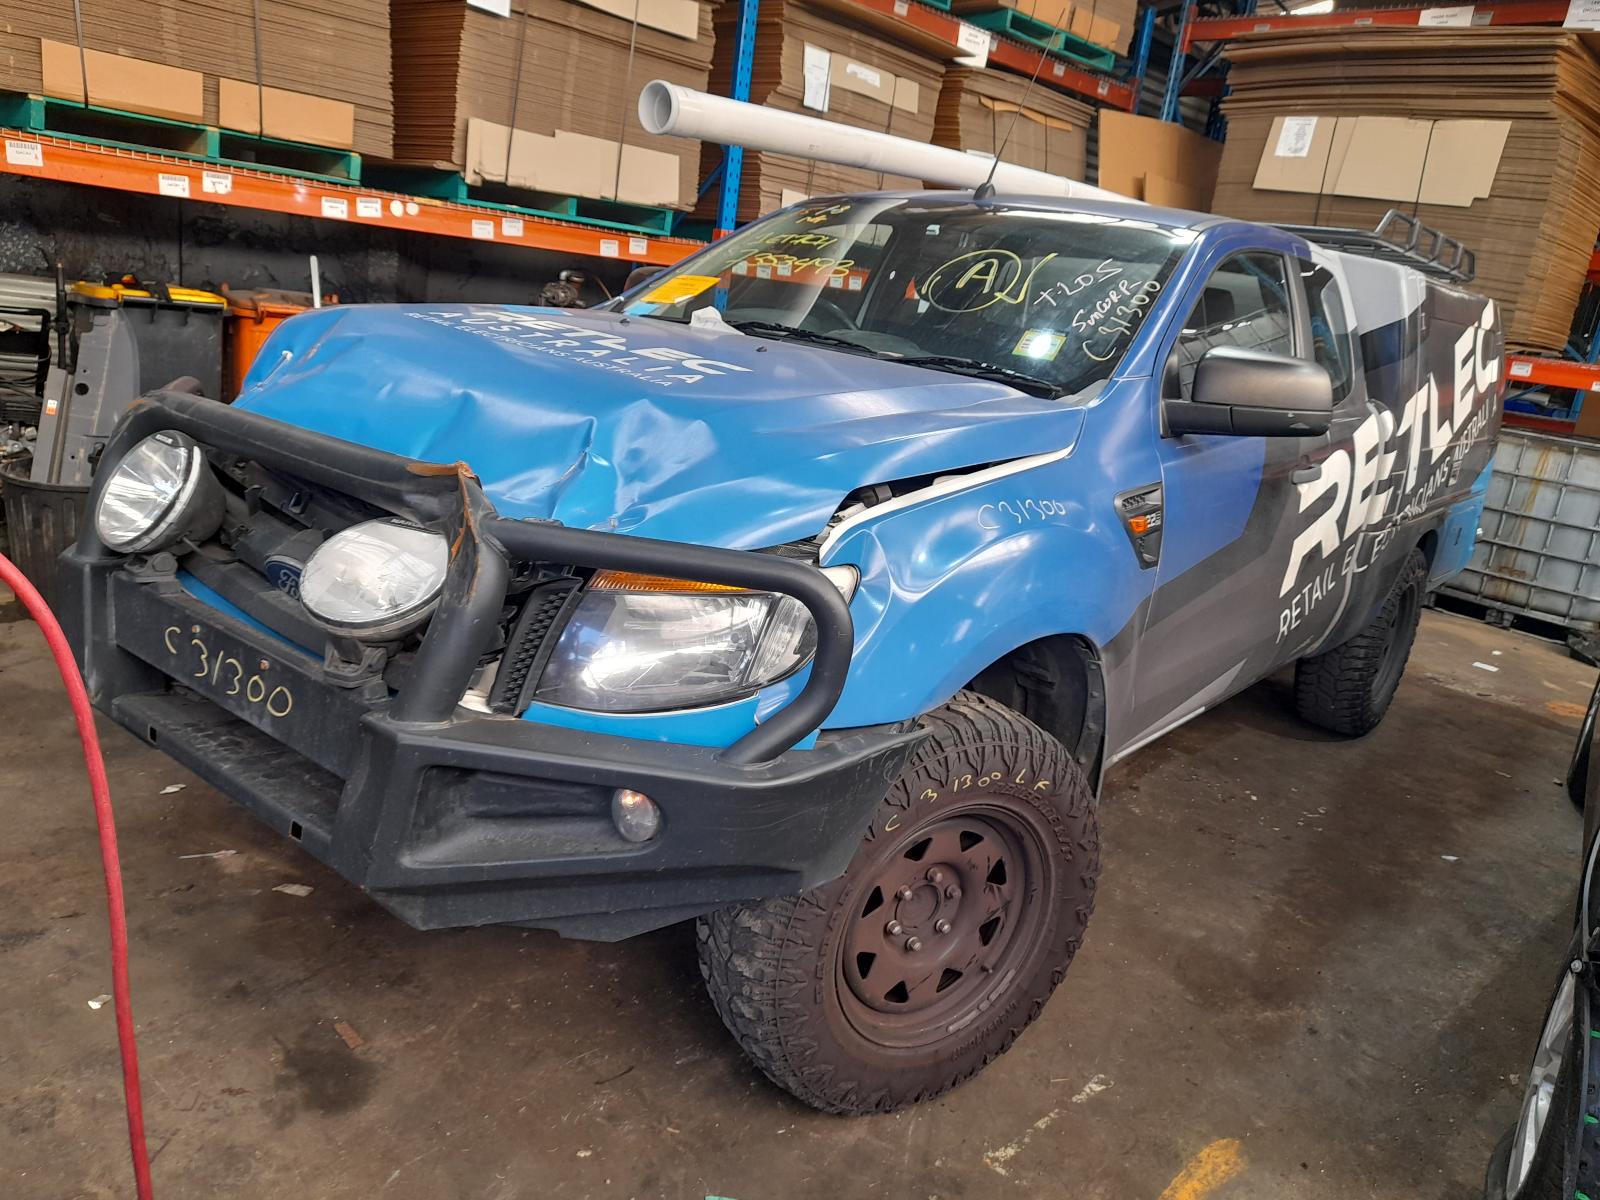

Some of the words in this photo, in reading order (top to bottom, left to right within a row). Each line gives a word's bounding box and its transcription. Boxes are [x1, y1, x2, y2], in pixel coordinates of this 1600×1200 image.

[955, 258, 999, 294] A
[427, 312, 705, 385] AUSTRALIA
[470, 311, 753, 376] RETLEC
[569, 355, 674, 388] AUSTRALIA
[1278, 298, 1500, 599] RETLEC
[1275, 561, 1337, 645] RETAIL
